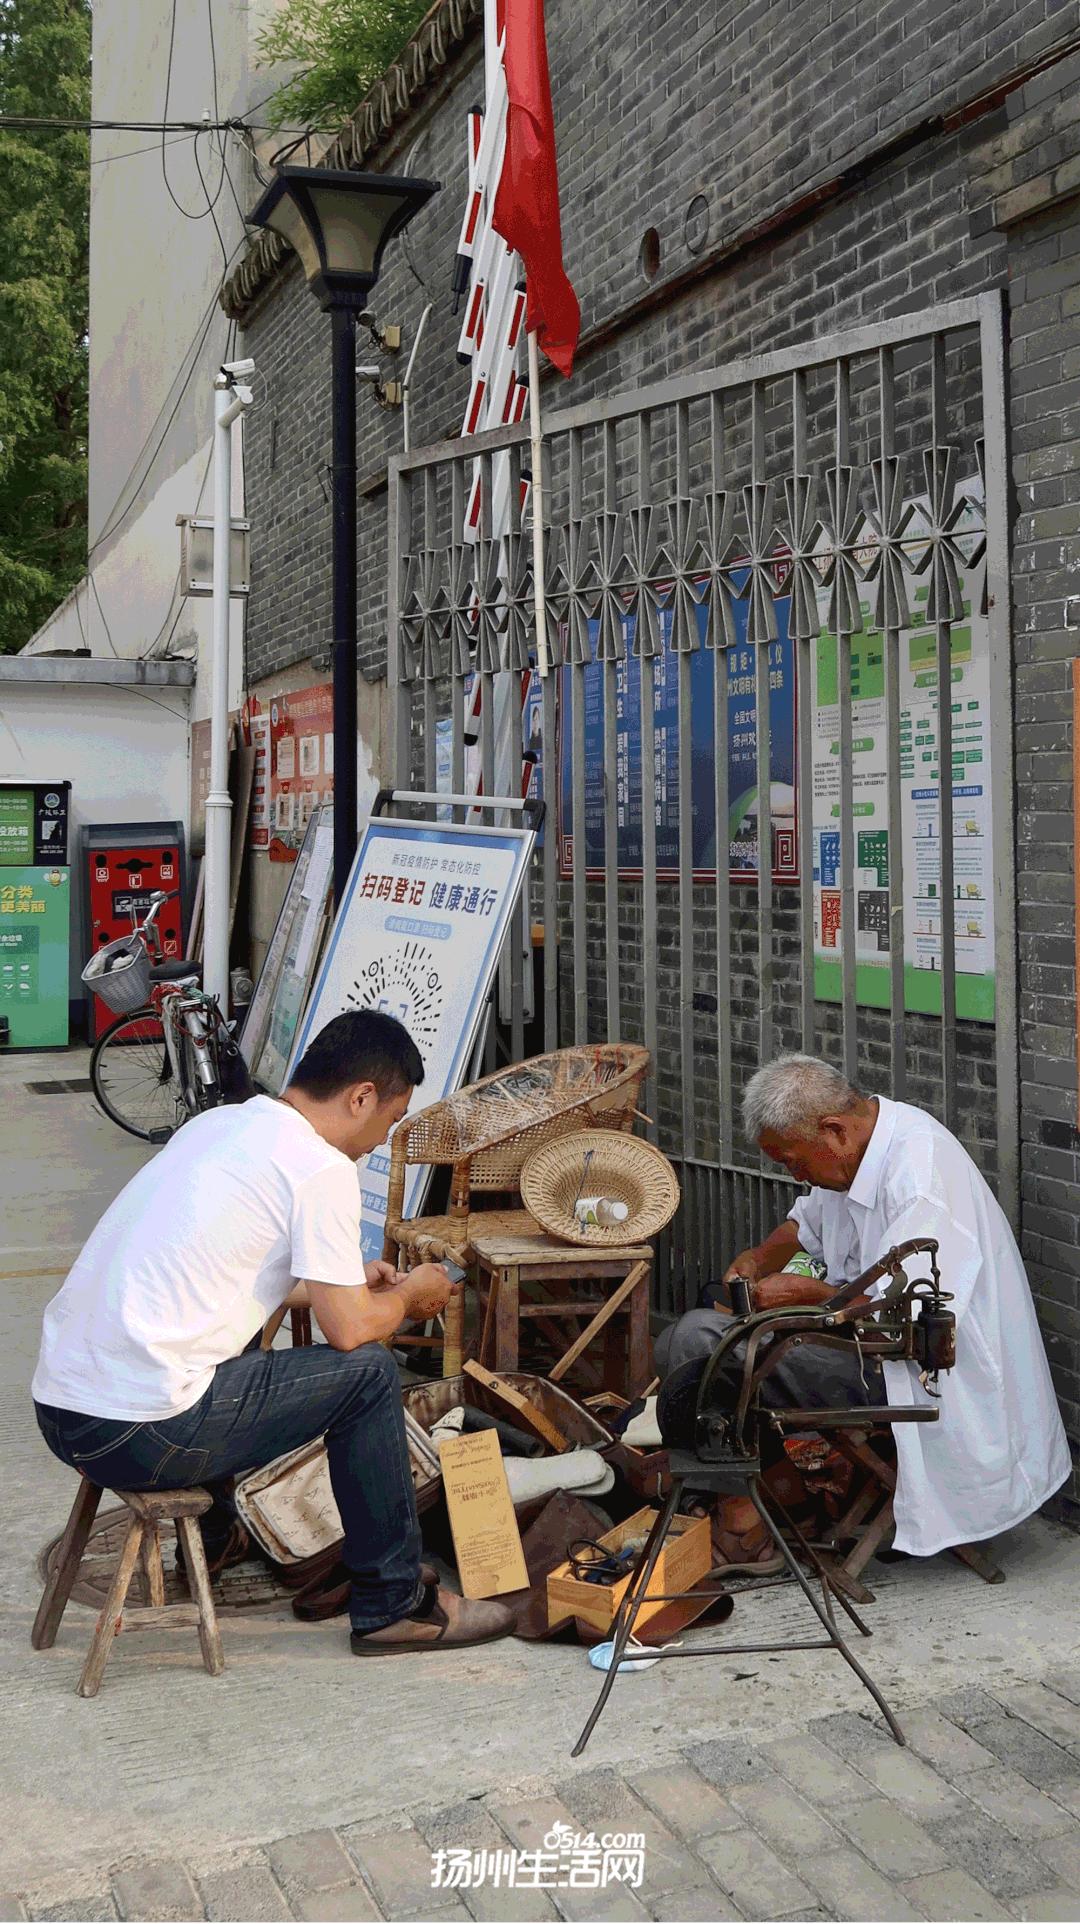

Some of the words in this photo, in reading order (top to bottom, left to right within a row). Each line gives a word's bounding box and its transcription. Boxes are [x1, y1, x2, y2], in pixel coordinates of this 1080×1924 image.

[392, 853, 439, 871] 新冠疫情防护
[440, 860, 481, 876] 常态化防控
[1, 885, 33, 899] 分类
[360, 872, 426, 906] 扫码登记
[429, 881, 498, 917] 健康通行
[1, 900, 46, 913] 更美丽
